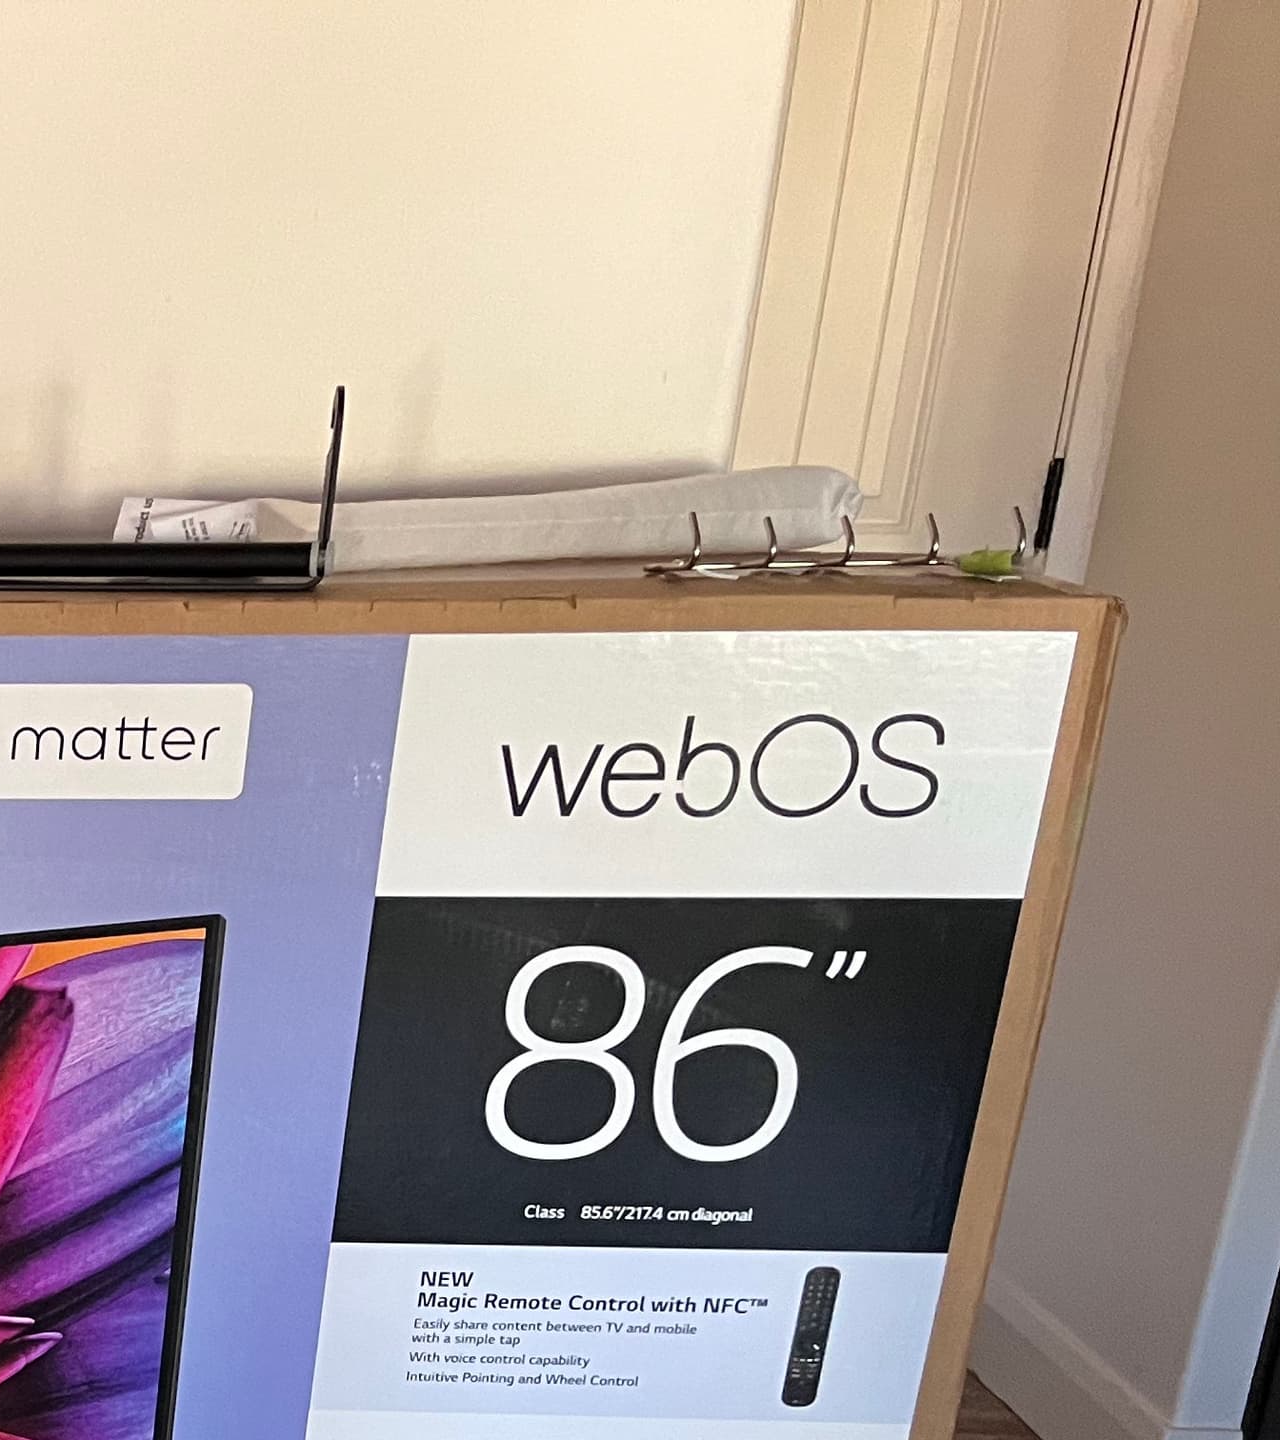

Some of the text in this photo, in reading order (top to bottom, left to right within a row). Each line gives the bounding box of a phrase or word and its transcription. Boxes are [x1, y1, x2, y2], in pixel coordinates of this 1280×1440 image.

[10, 718, 221, 763] matter
[499, 713, 946, 820] webOS
[524, 1204, 565, 1220] Class
[667, 1209, 690, 1221] cm
[691, 1206, 753, 1225] diagonal
[420, 1271, 474, 1287] NEW
[417, 1292, 477, 1312] Magic
[484, 1293, 561, 1311] Remote
[568, 1294, 645, 1313] Control
[650, 1296, 697, 1313] with
[414, 1318, 698, 1336] Easily share content between TV and mobile
[412, 1332, 521, 1348] with a simple tap
[409, 1351, 590, 1369] With voice control capability
[406, 1371, 639, 1388] Intuitive Pointing and Wheel Control
